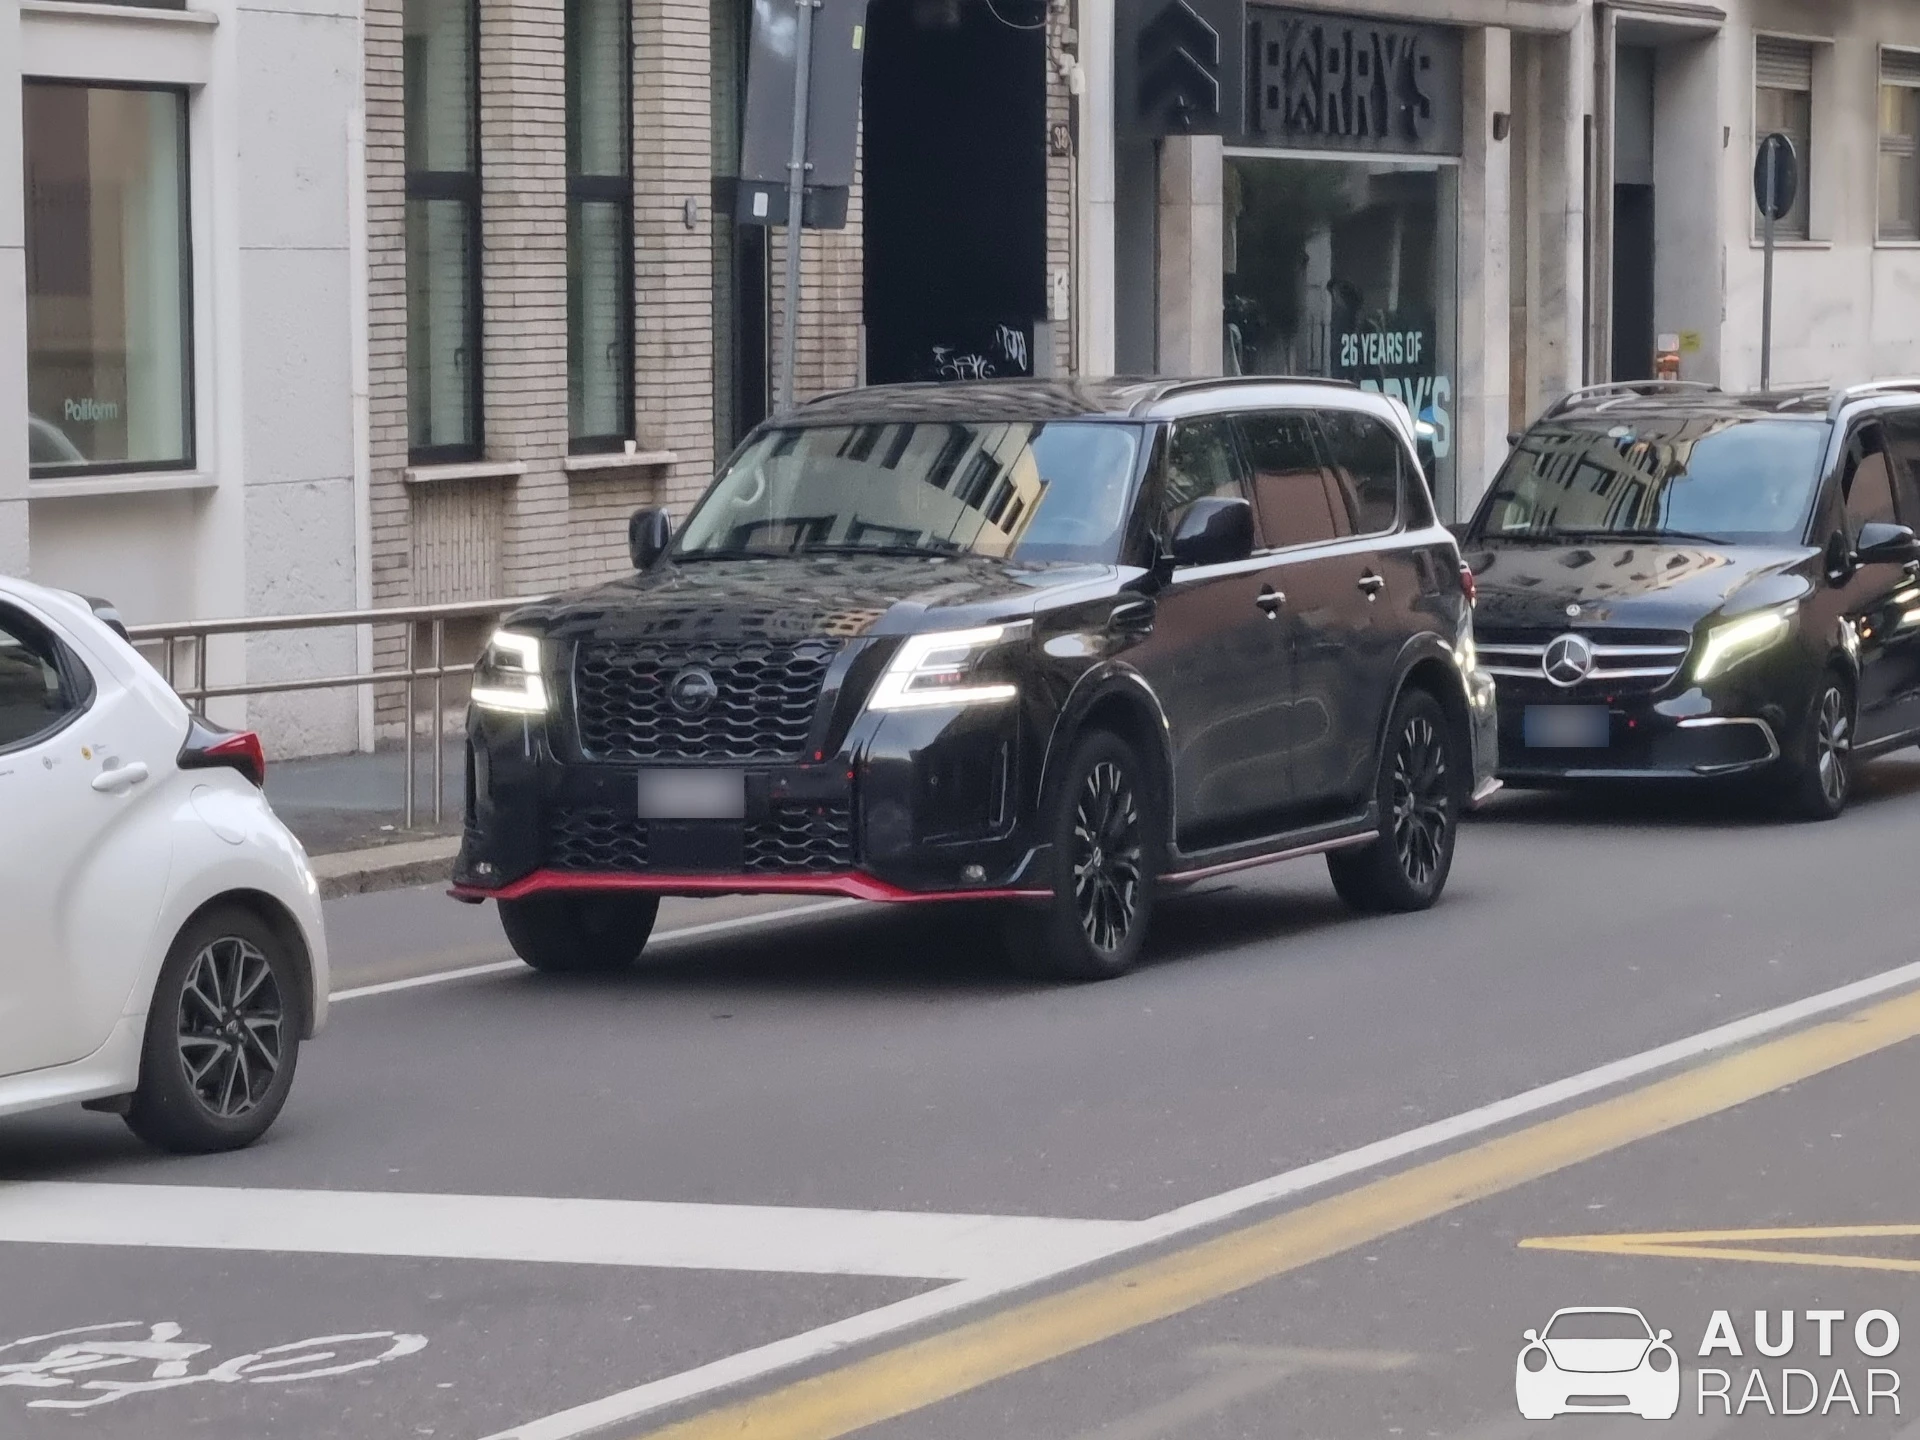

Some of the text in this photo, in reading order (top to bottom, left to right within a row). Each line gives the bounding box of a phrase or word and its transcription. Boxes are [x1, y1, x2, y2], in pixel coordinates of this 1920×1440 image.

[1259, 17, 1434, 139] BARRY'S
[1340, 331, 1423, 367] 26 YEARS OF
[64, 398, 118, 421] Poliform
